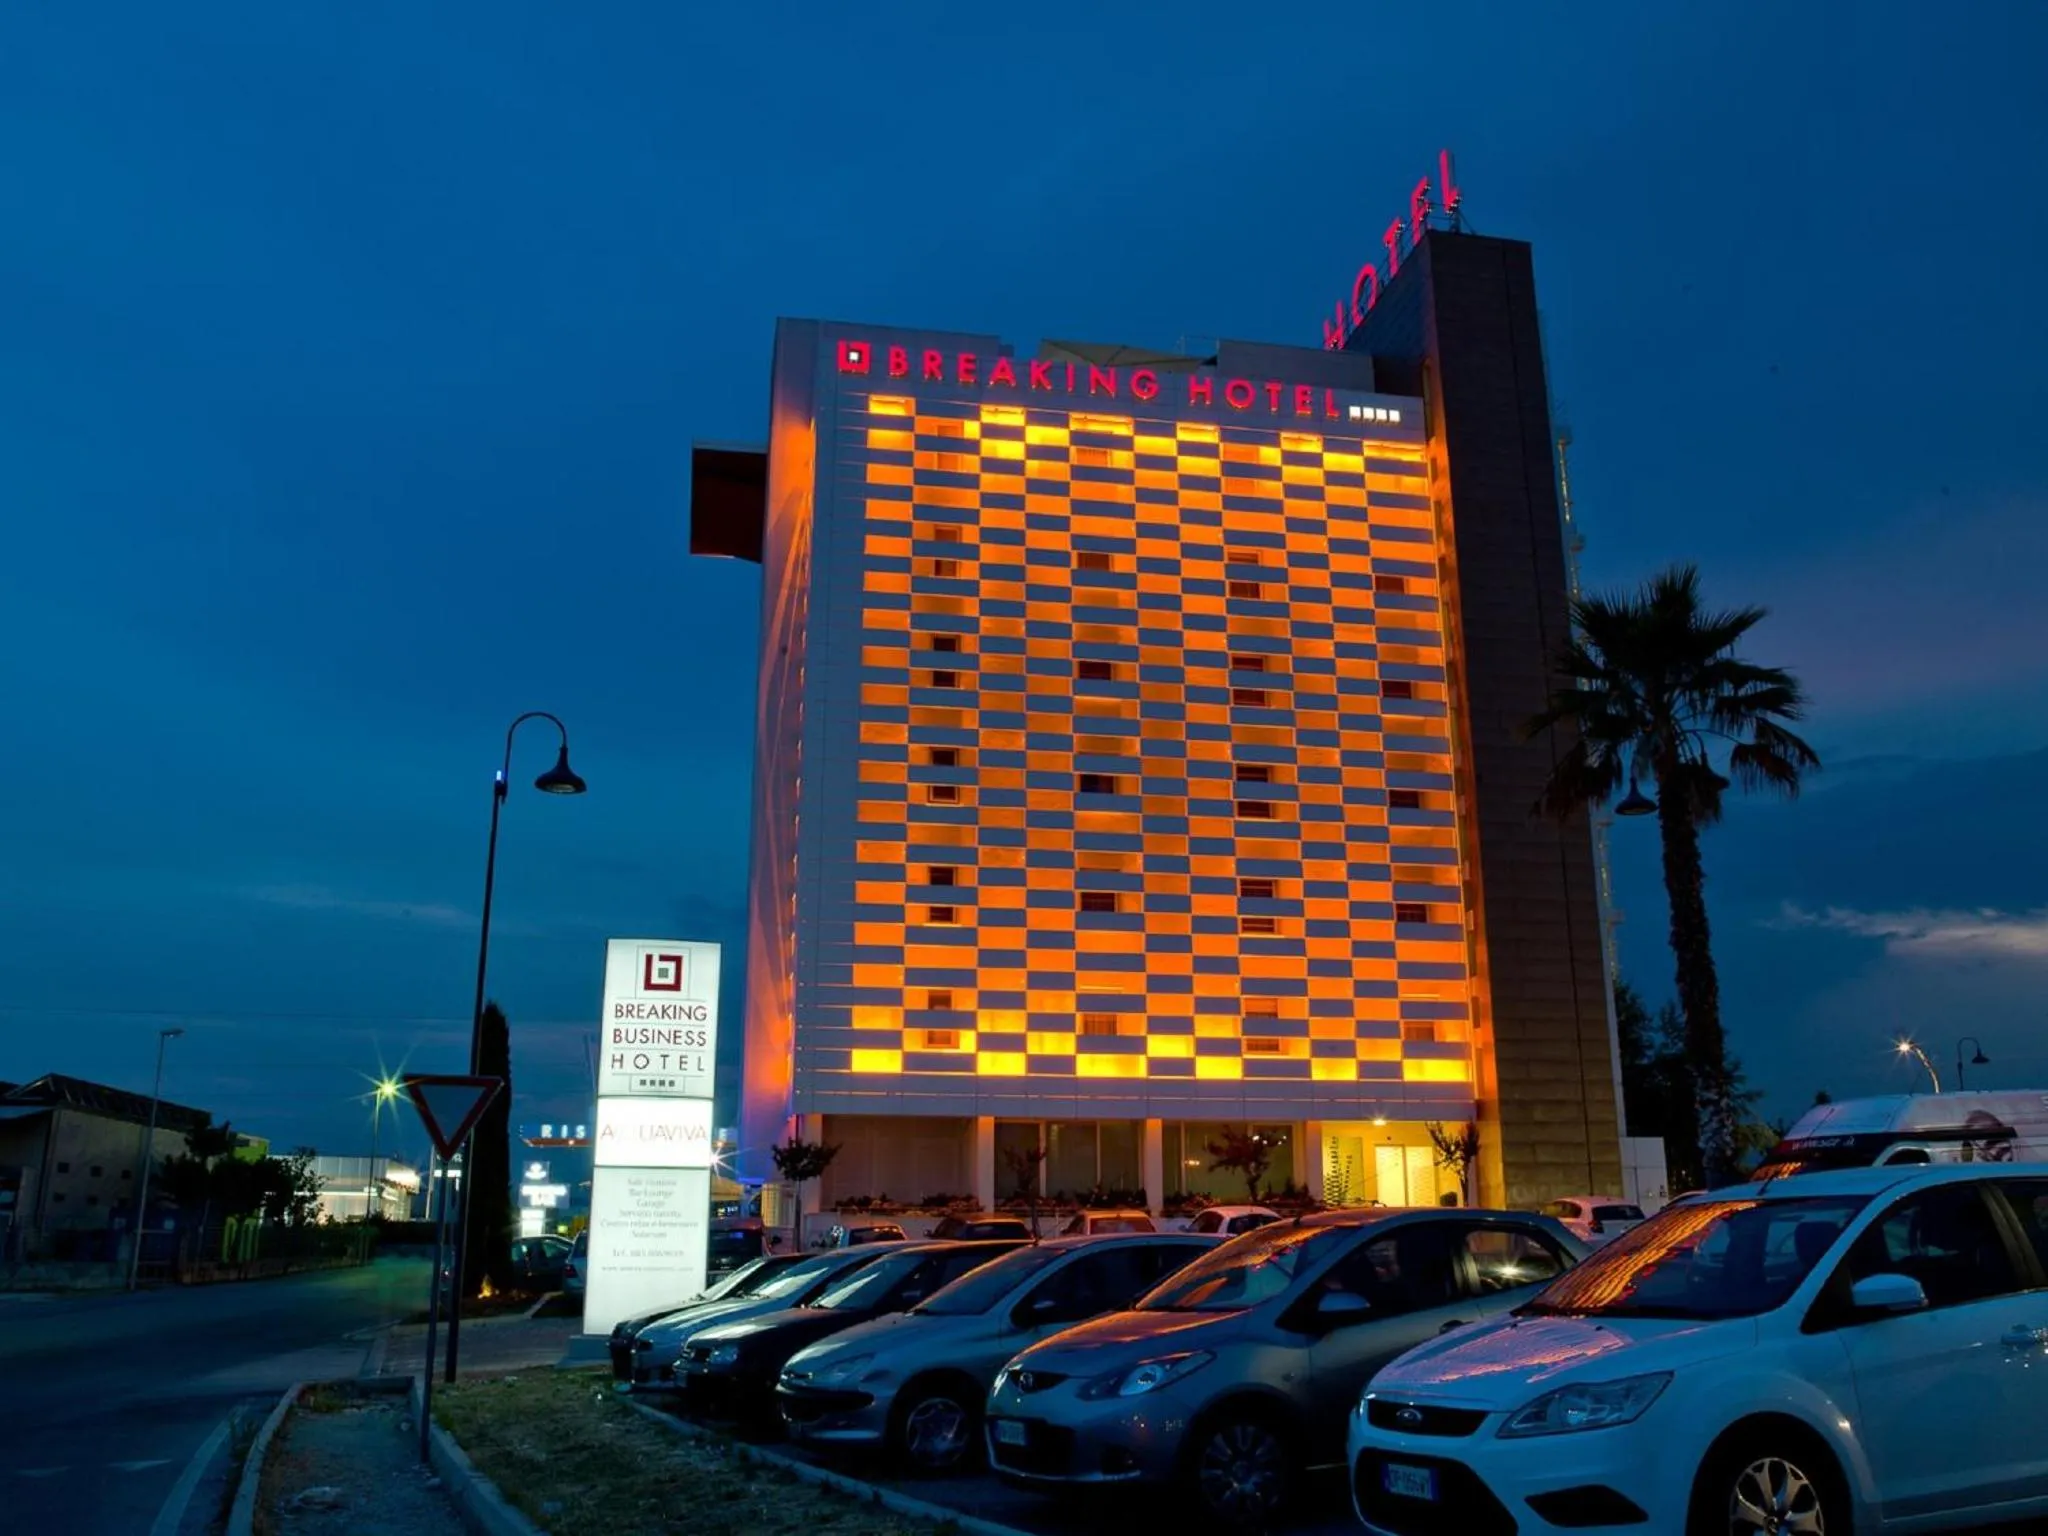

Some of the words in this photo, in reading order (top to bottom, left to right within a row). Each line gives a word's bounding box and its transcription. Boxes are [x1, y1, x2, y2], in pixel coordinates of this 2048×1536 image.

[1323, 148, 1460, 350] HOTEL
[889, 344, 1159, 401] BREAKING
[1188, 373, 1342, 417] HOTEL
[614, 1003, 708, 1022] BREAKING
[612, 1028, 708, 1047] BUSINESS
[611, 1053, 705, 1073] HOTEL
[600, 1124, 707, 1140] AUAVIVA
